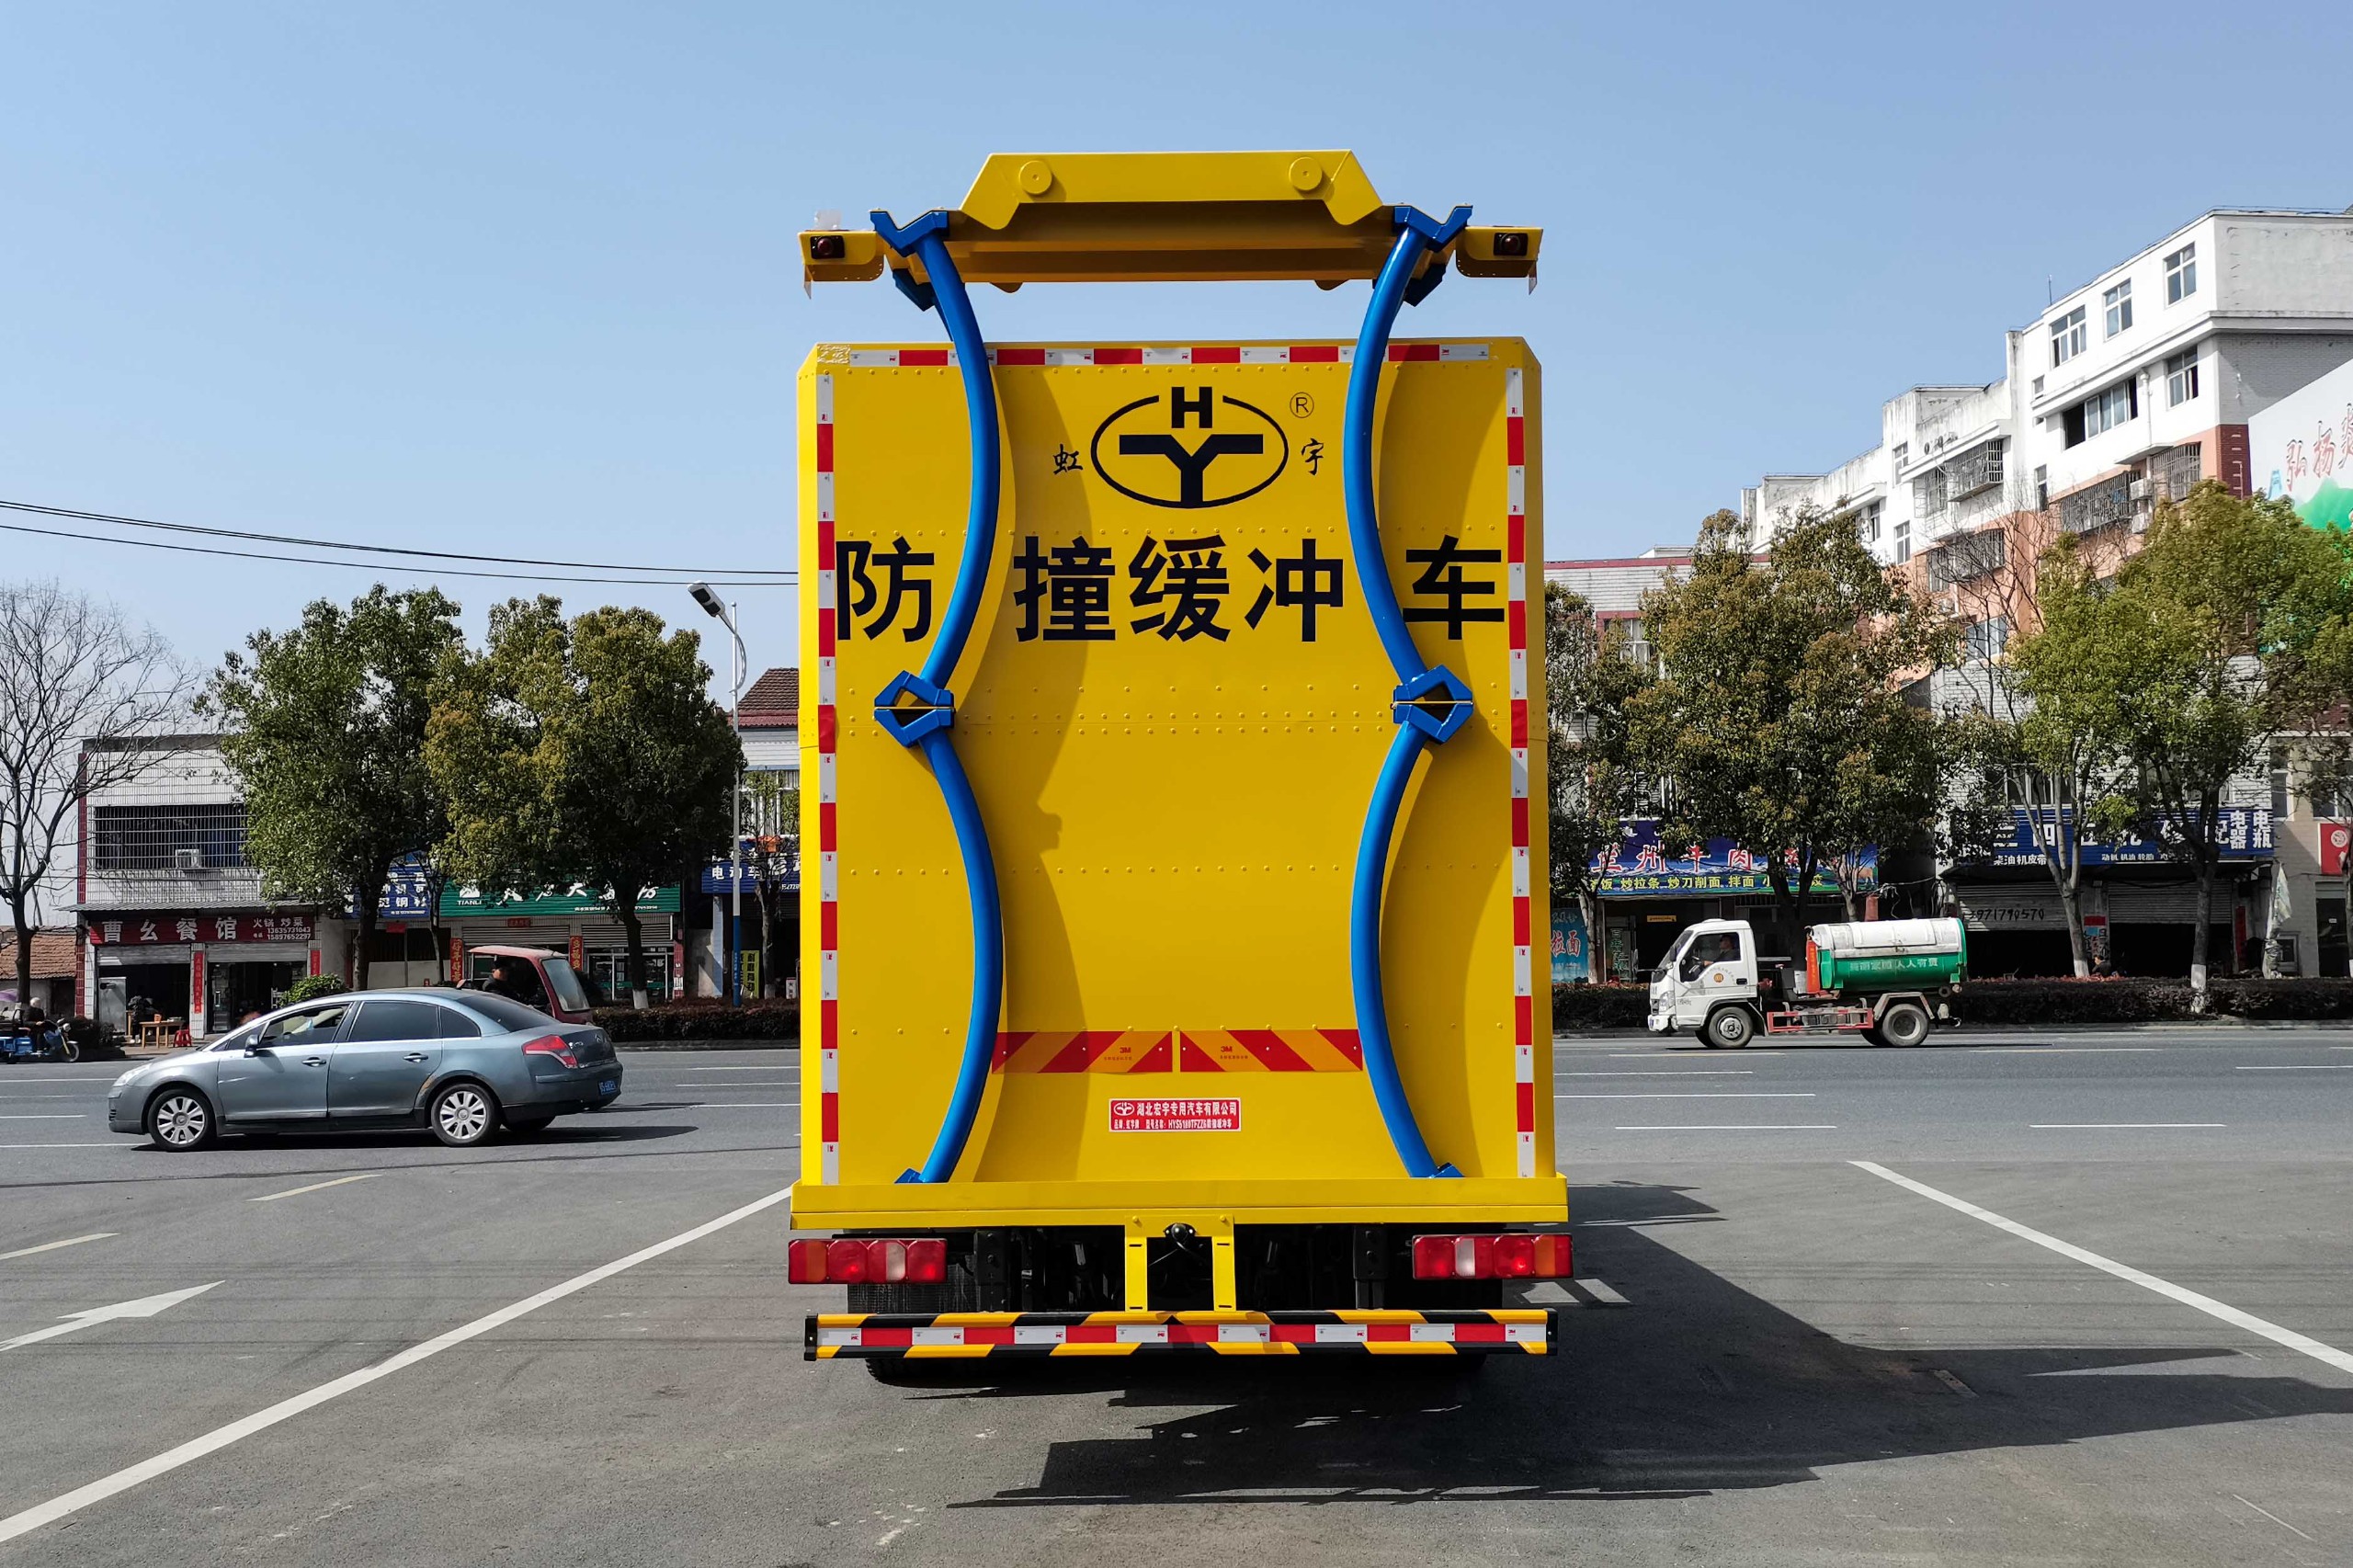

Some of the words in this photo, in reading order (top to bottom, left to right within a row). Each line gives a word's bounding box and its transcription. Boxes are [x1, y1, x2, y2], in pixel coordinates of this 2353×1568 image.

[2253, 810, 2273, 848] 电瓶
[1620, 878, 1660, 890] 炒拉条
[253, 918, 275, 928] 火锅
[280, 916, 304, 927] 炒菜
